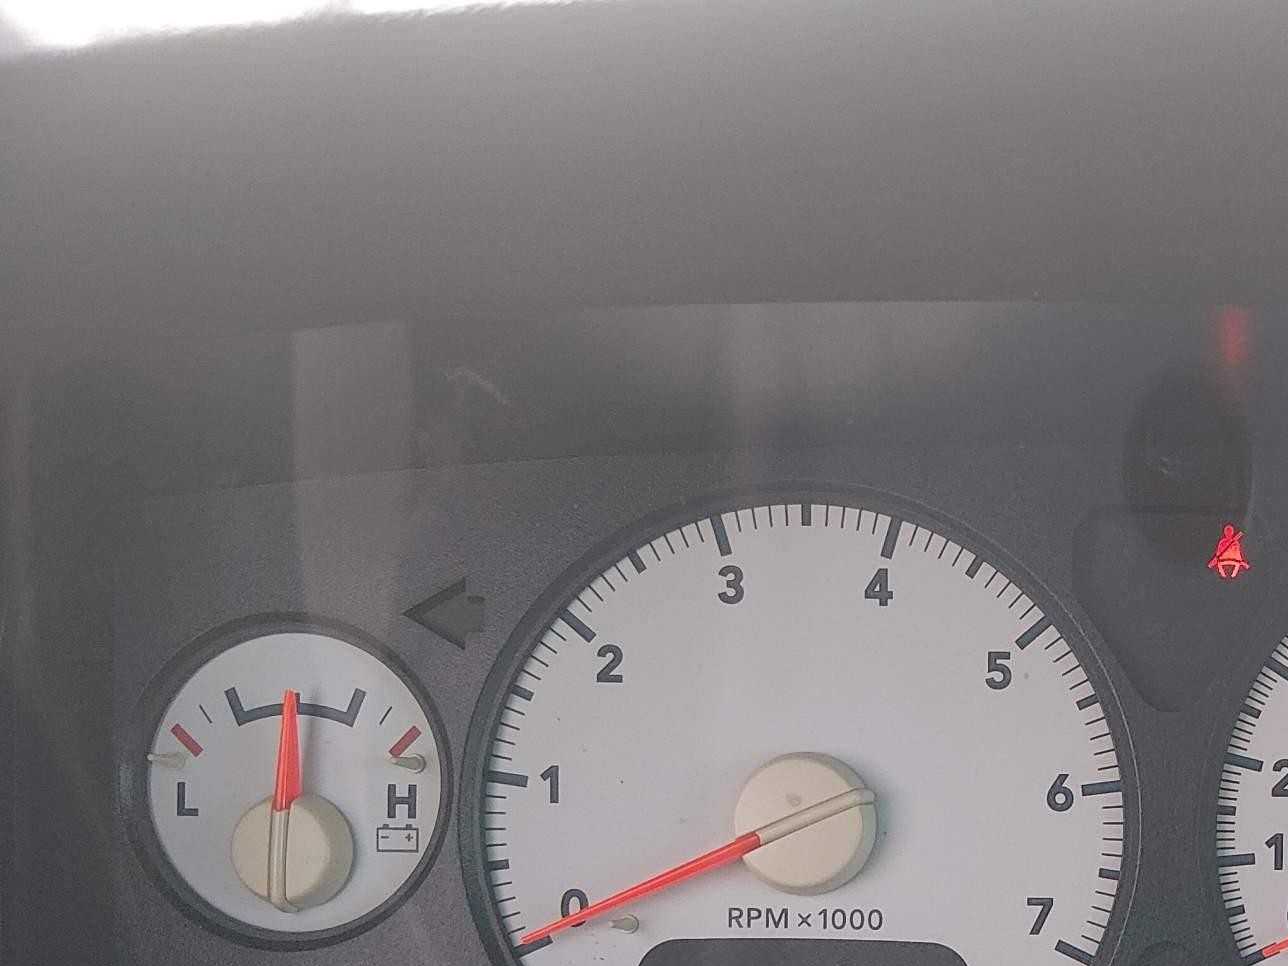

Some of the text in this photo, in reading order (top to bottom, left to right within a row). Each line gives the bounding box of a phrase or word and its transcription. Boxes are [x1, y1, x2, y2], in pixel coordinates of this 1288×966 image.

[718, 565, 744, 604] 3
[865, 568, 893, 606] 4
[594, 643, 623, 683] 2
[986, 652, 1011, 689] 5
[177, 782, 198, 816] L
[388, 784, 416, 818] H
[540, 765, 559, 803] 1
[1047, 774, 1074, 812] 6
[560, 887, 590, 928] 0
[729, 908, 788, 928] RPM
[1027, 898, 1053, 935] 7
